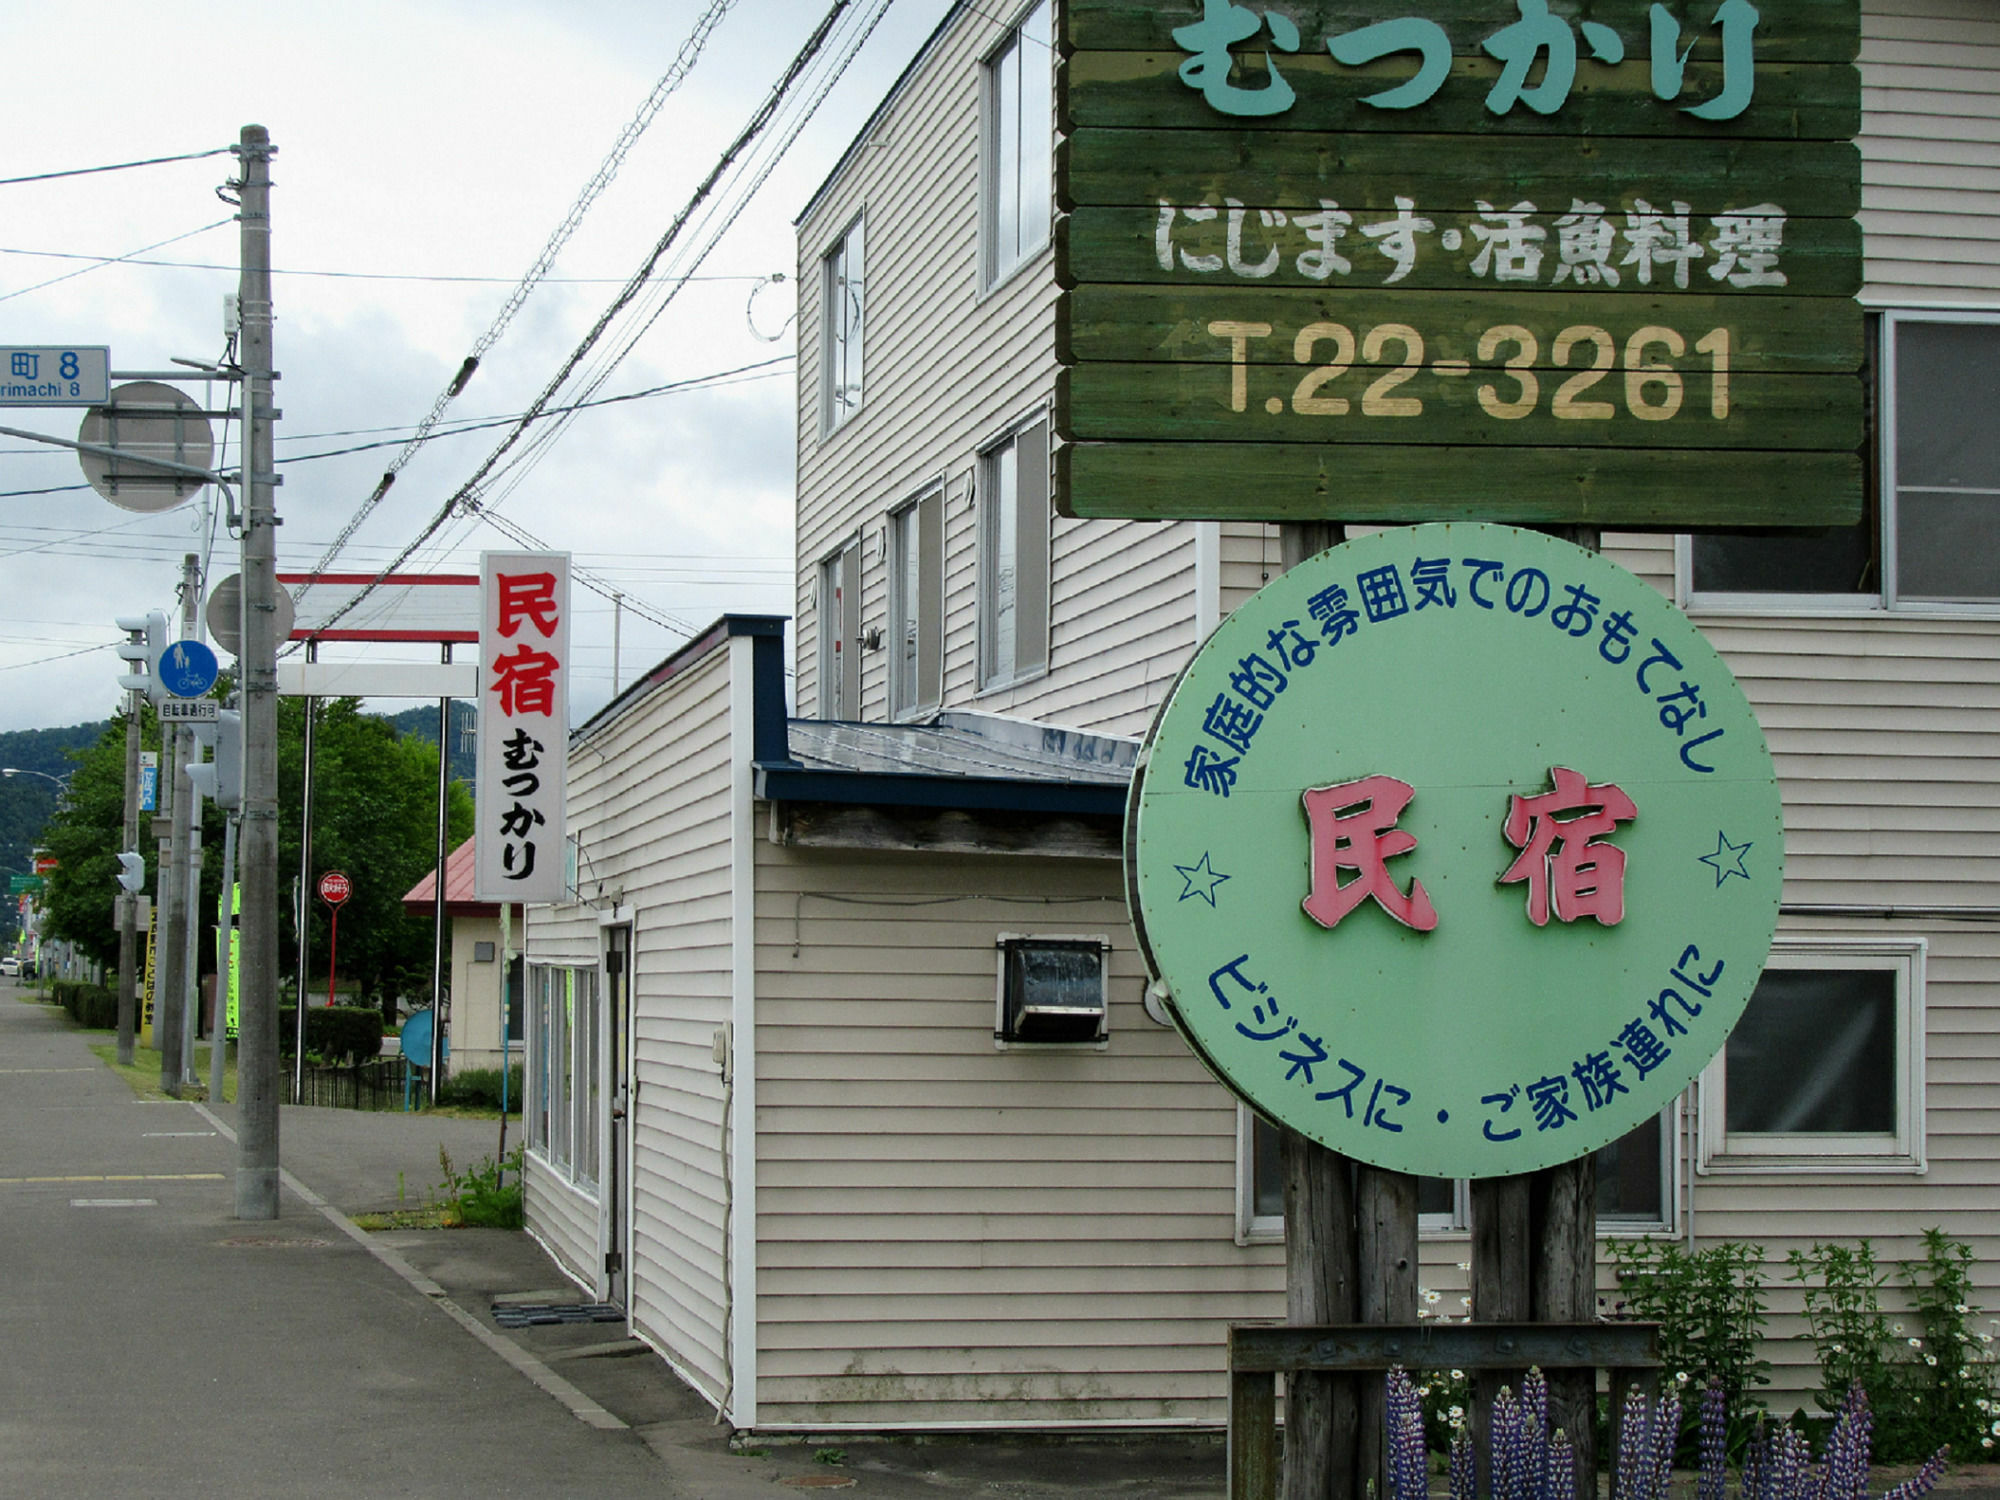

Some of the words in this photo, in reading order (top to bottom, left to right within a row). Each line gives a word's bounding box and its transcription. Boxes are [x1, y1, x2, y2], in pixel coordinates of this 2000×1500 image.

[1172, 0, 1759, 121] むつかり
[1154, 195, 1788, 289] にじます・活魚料理
[59, 351, 80, 380] 8
[69, 381, 80, 397] 8
[1207, 320, 1730, 421] T.22-3261
[489, 571, 560, 718] 民宿
[1183, 556, 1725, 798] 家庭的な雰囲気でのおもてなし
[499, 727, 546, 881] むつかり
[1300, 765, 1640, 932] 民宿
